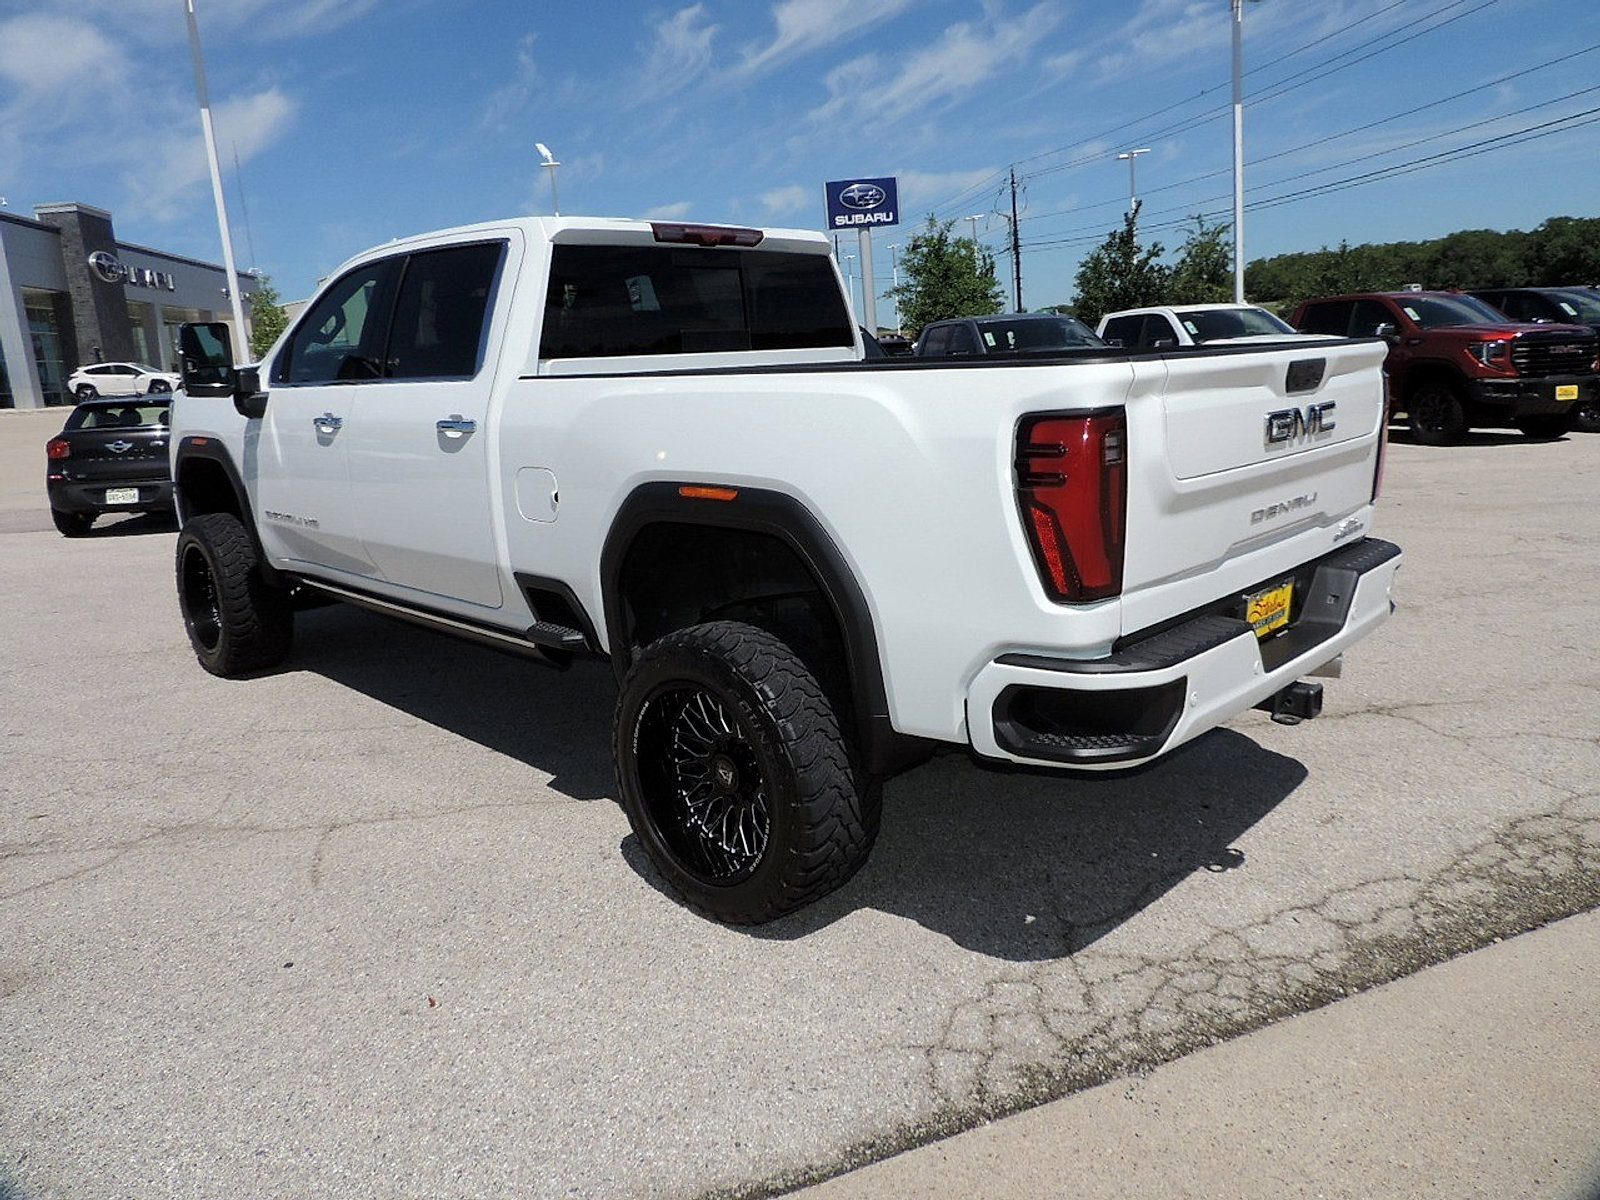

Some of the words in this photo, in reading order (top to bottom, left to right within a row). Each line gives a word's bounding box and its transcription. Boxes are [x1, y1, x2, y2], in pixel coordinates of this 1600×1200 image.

[835, 212, 893, 226] SUBARU
[1263, 400, 1336, 443] GMC
[1250, 492, 1318, 524] DENALI
